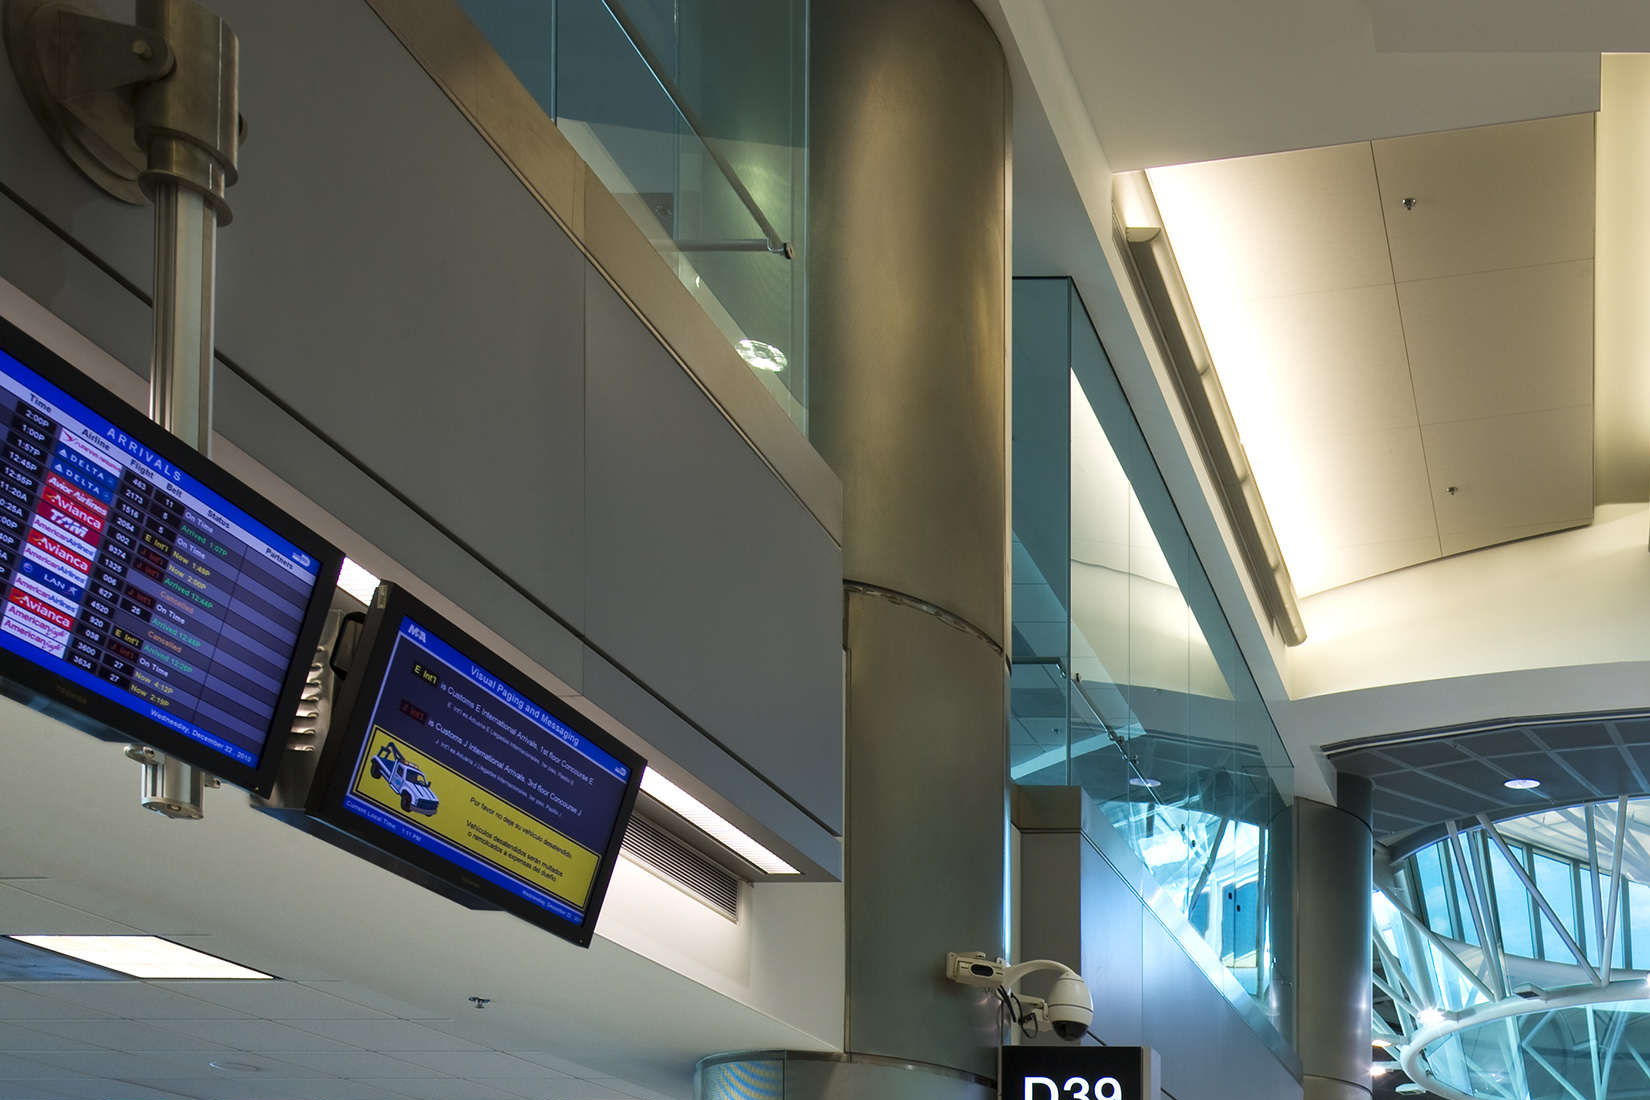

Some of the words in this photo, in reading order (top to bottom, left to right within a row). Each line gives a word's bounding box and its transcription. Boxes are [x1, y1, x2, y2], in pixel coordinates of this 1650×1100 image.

[21, 423, 45, 443] 1:00P
[70, 454, 104, 480] DELTA
[125, 488, 143, 505] 2173
[162, 511, 168, 520] 5
[181, 524, 206, 544] Arrived
[25, 409, 49, 429] 2:00P
[164, 498, 173, 508] 11
[185, 511, 196, 522] On
[196, 518, 213, 533] Time
[29, 393, 52, 413] Time
[81, 427, 110, 451] Airline
[129, 458, 154, 480] Flight
[166, 482, 182, 497] Belt
[207, 509, 230, 528] Status
[265, 547, 293, 570] Partners
[106, 425, 182, 482] ARRIVALS
[0, 480, 28, 502] 11:20A
[48, 508, 88, 539] TAM
[164, 577, 189, 596] Arrived
[3, 466, 32, 488] 12:55P
[51, 491, 102, 529] Avianca
[115, 532, 129, 545] 002
[168, 564, 184, 578] Now
[187, 575, 206, 590] 2:00P
[8, 450, 37, 473] 12:45P
[48, 474, 73, 495] Avior
[72, 489, 108, 516] Airlines
[116, 516, 134, 532] 2054
[145, 533, 151, 542] E
[172, 550, 189, 565] Now
[17, 438, 40, 458] 1:57P
[65, 468, 100, 494] DELTA
[121, 503, 139, 519] 1516
[157, 525, 163, 534] 5
[176, 537, 188, 548] On
[188, 544, 205, 559] Time
[37, 534, 89, 571] Avianca
[155, 603, 167, 614] On
[167, 610, 185, 625] Time
[43, 573, 65, 590] LAN
[90, 599, 109, 614] 4520
[147, 629, 182, 653] Cancelled
[104, 558, 122, 573] 1325
[159, 590, 194, 614] Cancelled
[4, 618, 46, 645] American
[109, 673, 119, 683] 27
[130, 683, 147, 696] Now
[8, 604, 50, 631] American
[113, 660, 123, 670] 27
[134, 671, 151, 684] Now
[19, 593, 71, 627] Avianca
[139, 657, 150, 667] On
[151, 663, 169, 677] Time
[115, 629, 121, 637] E
[143, 643, 169, 662] Arrived
[131, 605, 140, 615] 25
[152, 617, 177, 635] Arrived
[56, 684, 87, 704] TOSHIBA
[414, 664, 421, 673] E
[440, 681, 447, 690] is
[447, 685, 475, 708] Customs
[475, 703, 481, 712] E
[481, 707, 517, 736] International
[515, 730, 539, 751] Arrivals,
[539, 745, 548, 756] 1st
[548, 751, 561, 764] floor
[560, 759, 589, 782] Concourse
[588, 777, 593, 785] E
[469, 665, 496, 689] Visual
[495, 683, 525, 710] Paging
[524, 702, 540, 718] and
[539, 713, 579, 747] Messaging
[149, 708, 191, 734] Wednesday,
[192, 729, 223, 749] December
[236, 751, 251, 763] 2010
[428, 717, 435, 727] is
[434, 721, 463, 744] Customs
[463, 739, 468, 747] J
[468, 742, 504, 769] International
[526, 777, 537, 789] 3rd
[536, 783, 549, 797] floor
[549, 791, 578, 814] Concourse
[577, 808, 582, 816] J
[345, 800, 366, 814] Current
[367, 810, 382, 822] Local
[412, 833, 421, 842] PM
[469, 796, 480, 807] Por
[480, 802, 495, 815] favor
[495, 812, 502, 820] no
[502, 815, 514, 827] deje
[472, 832, 503, 853] remolcados
[507, 852, 531, 870] expensas
[532, 864, 541, 873] del
[492, 834, 526, 857] desatendidos
[541, 861, 563, 877] multados
